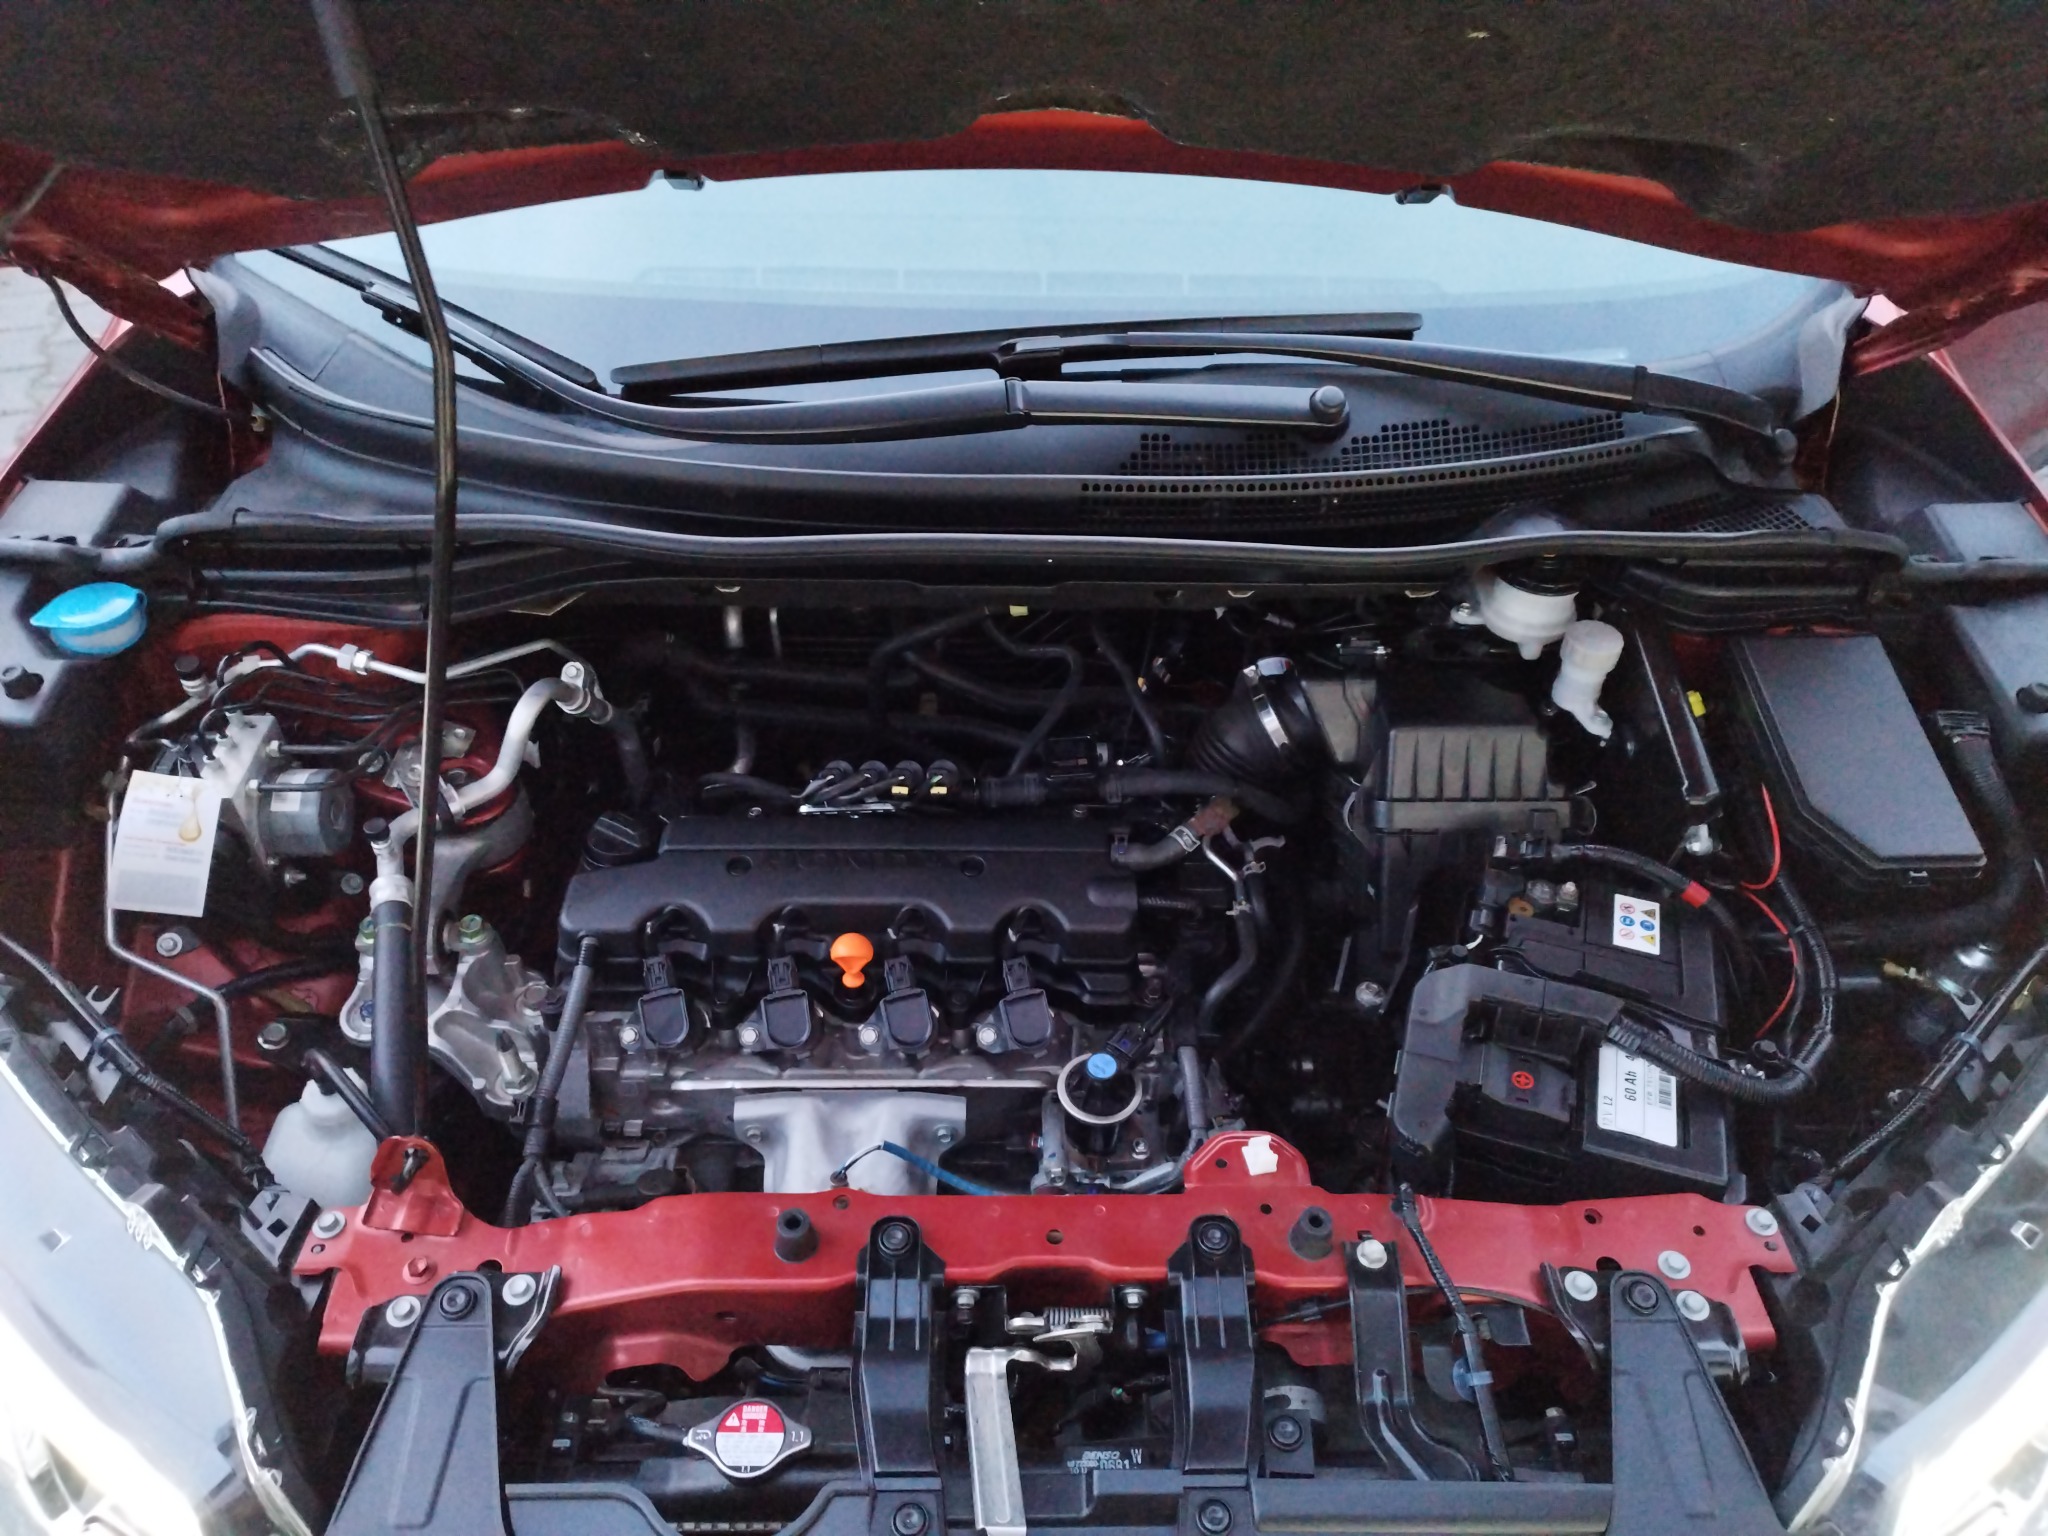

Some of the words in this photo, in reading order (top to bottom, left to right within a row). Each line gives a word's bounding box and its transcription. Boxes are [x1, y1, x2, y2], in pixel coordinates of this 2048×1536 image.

[1624, 1070, 1637, 1086] Ah
[1624, 1087, 1637, 1102] 60
[791, 1430, 804, 1442] 1.1
[1082, 1451, 1120, 1460] DENSO
